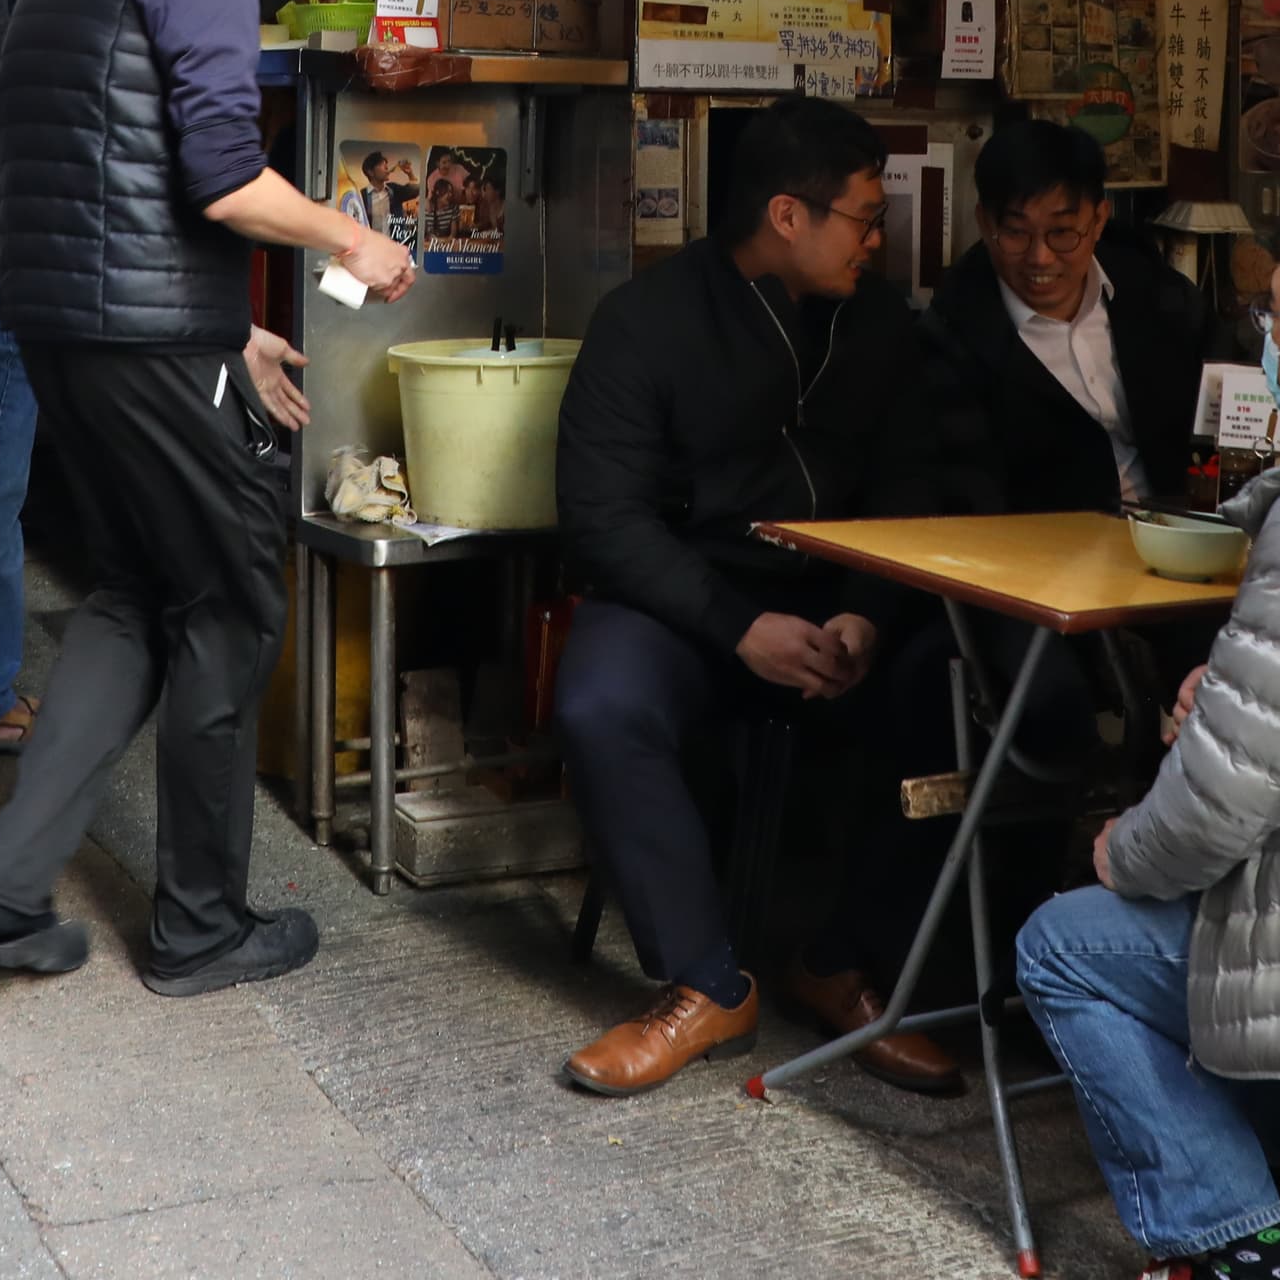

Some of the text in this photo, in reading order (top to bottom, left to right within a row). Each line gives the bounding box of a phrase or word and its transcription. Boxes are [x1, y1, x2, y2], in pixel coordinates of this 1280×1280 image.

[1167, 2, 1186, 118] 牛雜雙拼
[470, 228, 489, 239] Taste
[428, 238, 455, 253] Real
[457, 239, 501, 253] Moment
[446, 257, 464, 265] BLUE
